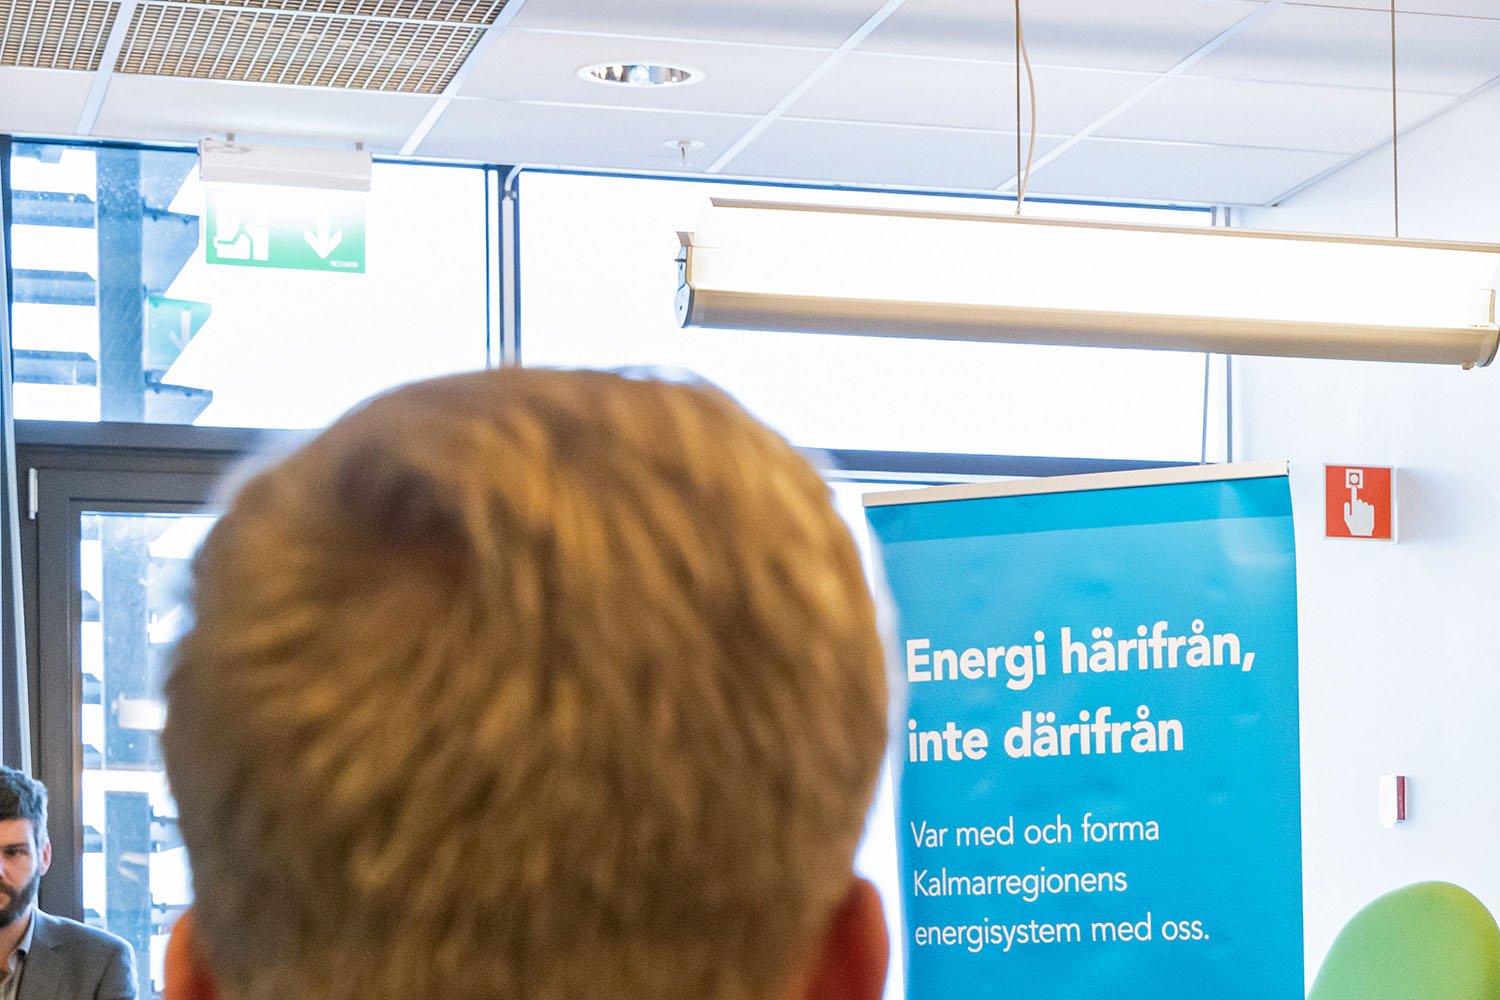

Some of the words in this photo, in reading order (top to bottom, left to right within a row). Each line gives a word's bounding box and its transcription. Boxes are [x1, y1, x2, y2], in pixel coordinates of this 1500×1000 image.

[907, 631, 1046, 690] Energi
[1061, 619, 1255, 673] härifrån,
[909, 719, 988, 762] inte
[1004, 705, 1183, 758] därifrån
[911, 820, 948, 848] Var
[955, 816, 1013, 846] med
[1024, 814, 1071, 844] och
[1080, 813, 1159, 842] forma
[914, 867, 1128, 902] Kalmarregionens
[915, 920, 1080, 952] energisystem
[1091, 913, 1152, 942] med
[1161, 918, 1209, 941] oss.
